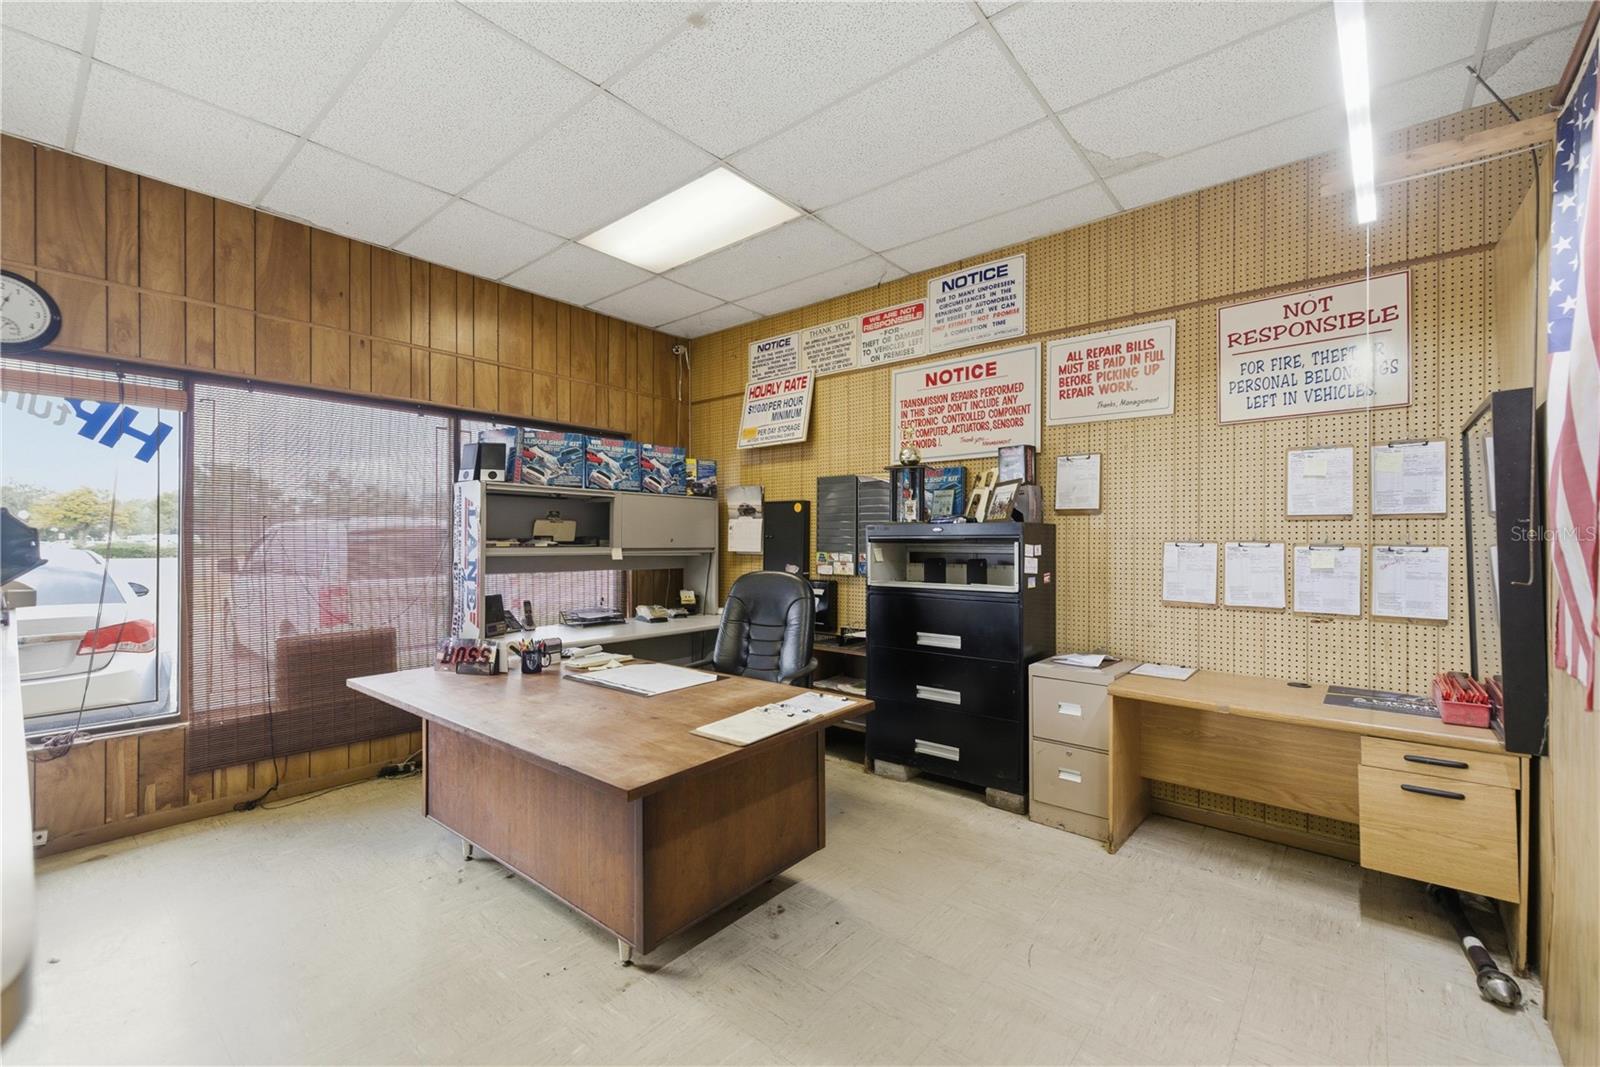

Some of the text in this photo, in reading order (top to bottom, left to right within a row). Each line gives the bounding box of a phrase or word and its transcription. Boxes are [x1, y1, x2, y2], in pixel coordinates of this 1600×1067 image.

[942, 264, 1008, 292] NOTICE
[958, 290, 975, 298] MANY
[978, 280, 1016, 292] UNFORESEEN
[900, 306, 916, 315] NOT
[935, 307, 962, 318] REPAIRING
[976, 294, 1016, 308] AUTOMOBILES
[939, 293, 986, 310] CIRCUMSTANCES
[1283, 296, 1333, 319] NOT
[864, 311, 922, 332] RESPONSIBLE
[993, 308, 1020, 318] PROMISE
[810, 322, 850, 337] THANK YOU
[950, 324, 987, 336] COMPLETION
[992, 320, 1006, 328] TIME
[1228, 304, 1399, 348] RESPONSIBLE
[757, 338, 791, 352] NOTICE
[862, 339, 879, 348] THEFT
[1066, 338, 1155, 362] ALL REPAIR BILLS
[1058, 350, 1165, 376] MUST BE PAID IN FULL
[1240, 360, 1264, 376] FOR
[1271, 354, 1304, 372] FIRE,
[1312, 346, 1357, 365] THEFT
[925, 362, 997, 387] NOTICE
[1058, 364, 1160, 388] BEFORE PICKING UP
[1229, 373, 1298, 394] PERSONAL
[748, 376, 808, 400] HOURLY RATE
[900, 382, 1024, 408] TRANSMISSION REPAIRS PERFORMED
[1059, 380, 1138, 400] REPAIR WORK.
[768, 400, 782, 411] PER
[784, 396, 804, 408] HOUR
[901, 395, 1018, 418] IN THIS SHOP DON'T INCLUDE ANY
[1120, 396, 1160, 407] Management
[1246, 393, 1278, 410] LEFT
[1283, 390, 1297, 406] IN
[772, 408, 802, 421] MINIMUM
[901, 404, 1032, 430] ELECTRONIC CONTROLLED COMPONENT
[768, 426, 776, 434] DAY
[778, 424, 800, 432] STORAGE
[915, 426, 951, 438] COMPUTER,
[952, 420, 992, 434] ACTUATORS,
[992, 417, 1024, 430] SENSORS
[466, 508, 478, 611] LANE
